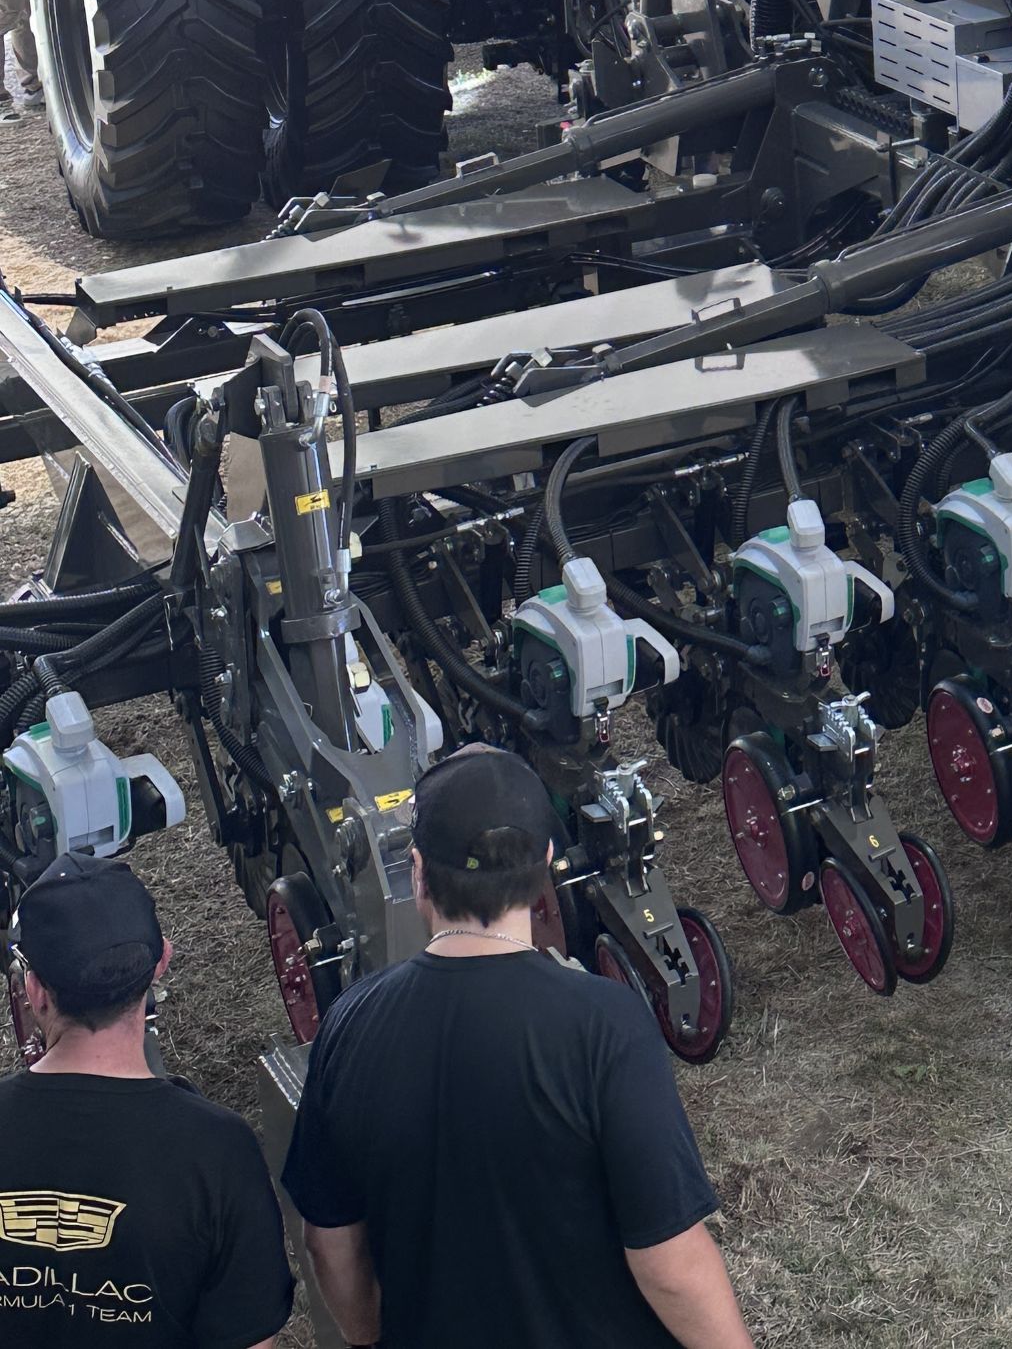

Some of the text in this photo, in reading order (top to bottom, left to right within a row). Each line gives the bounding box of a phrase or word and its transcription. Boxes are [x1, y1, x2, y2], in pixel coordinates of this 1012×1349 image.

[868, 834, 880, 848] 6
[643, 908, 655, 923] 5
[68, 1303, 76, 1317] 1
[86, 1304, 152, 1323] TEAM
